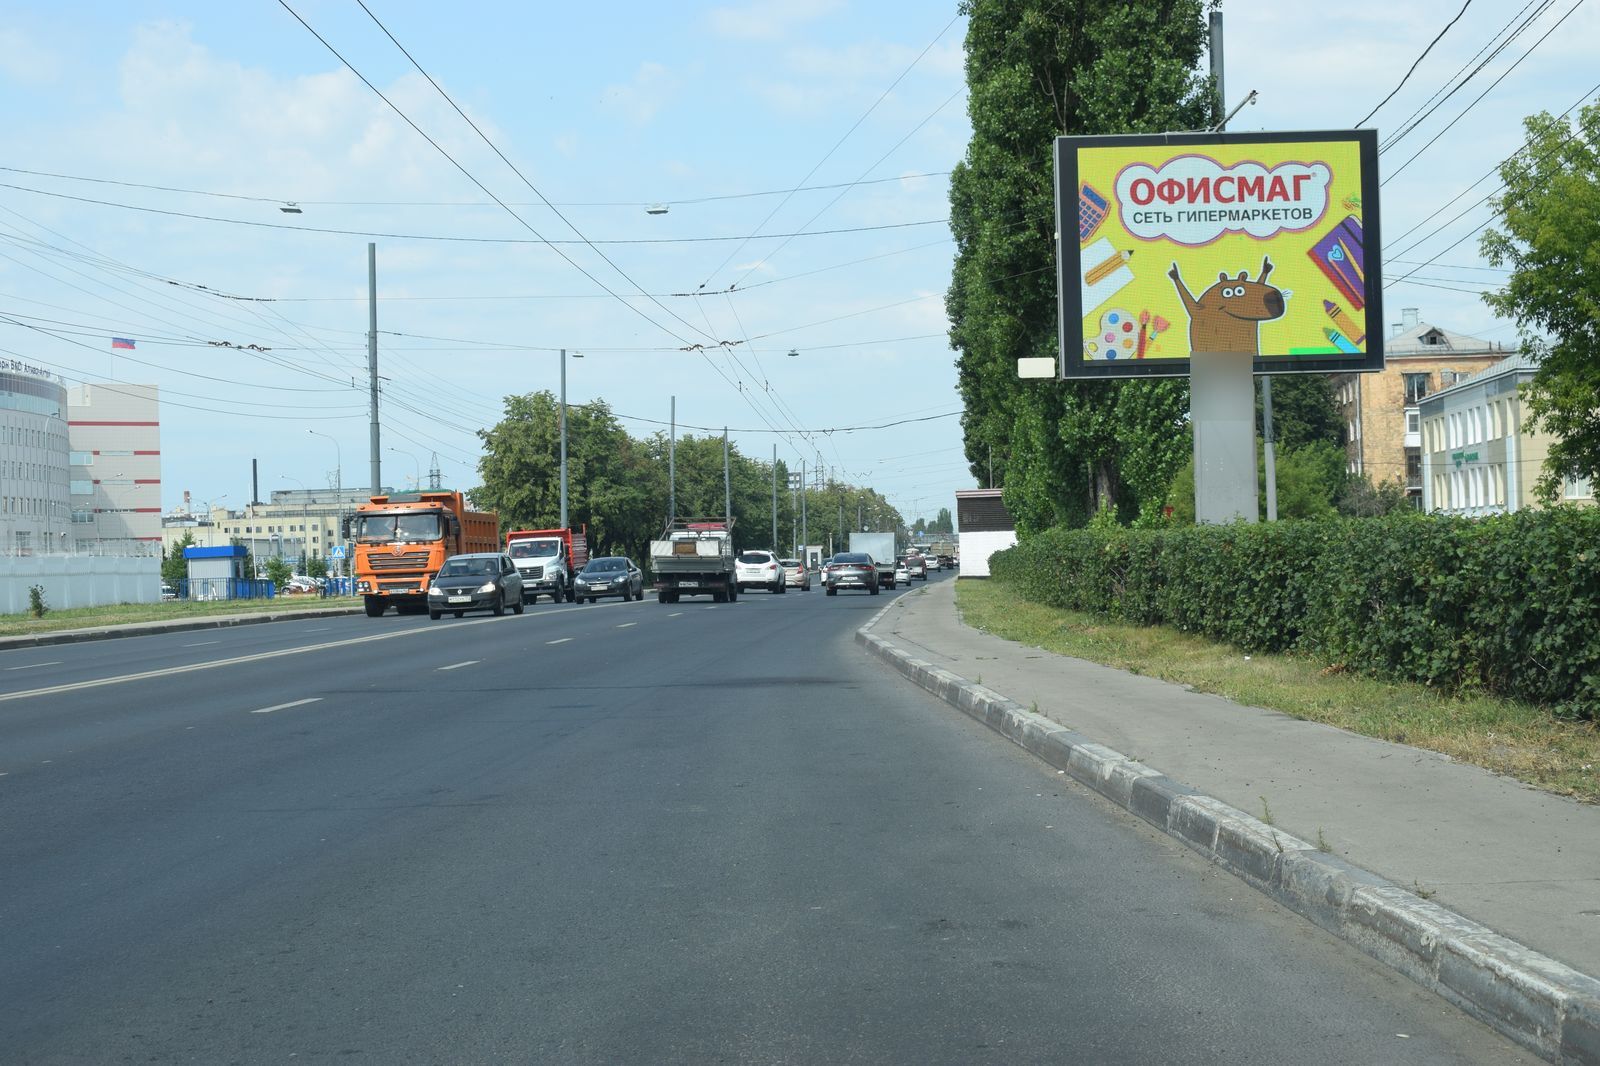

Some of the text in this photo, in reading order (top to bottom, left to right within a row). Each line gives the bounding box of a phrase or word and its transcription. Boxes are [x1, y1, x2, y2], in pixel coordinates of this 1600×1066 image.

[1129, 174, 1312, 206] ОФИСМАГ
[1133, 207, 1313, 224] СЕТЬ ГИПЕРМАРКЕТОВ
